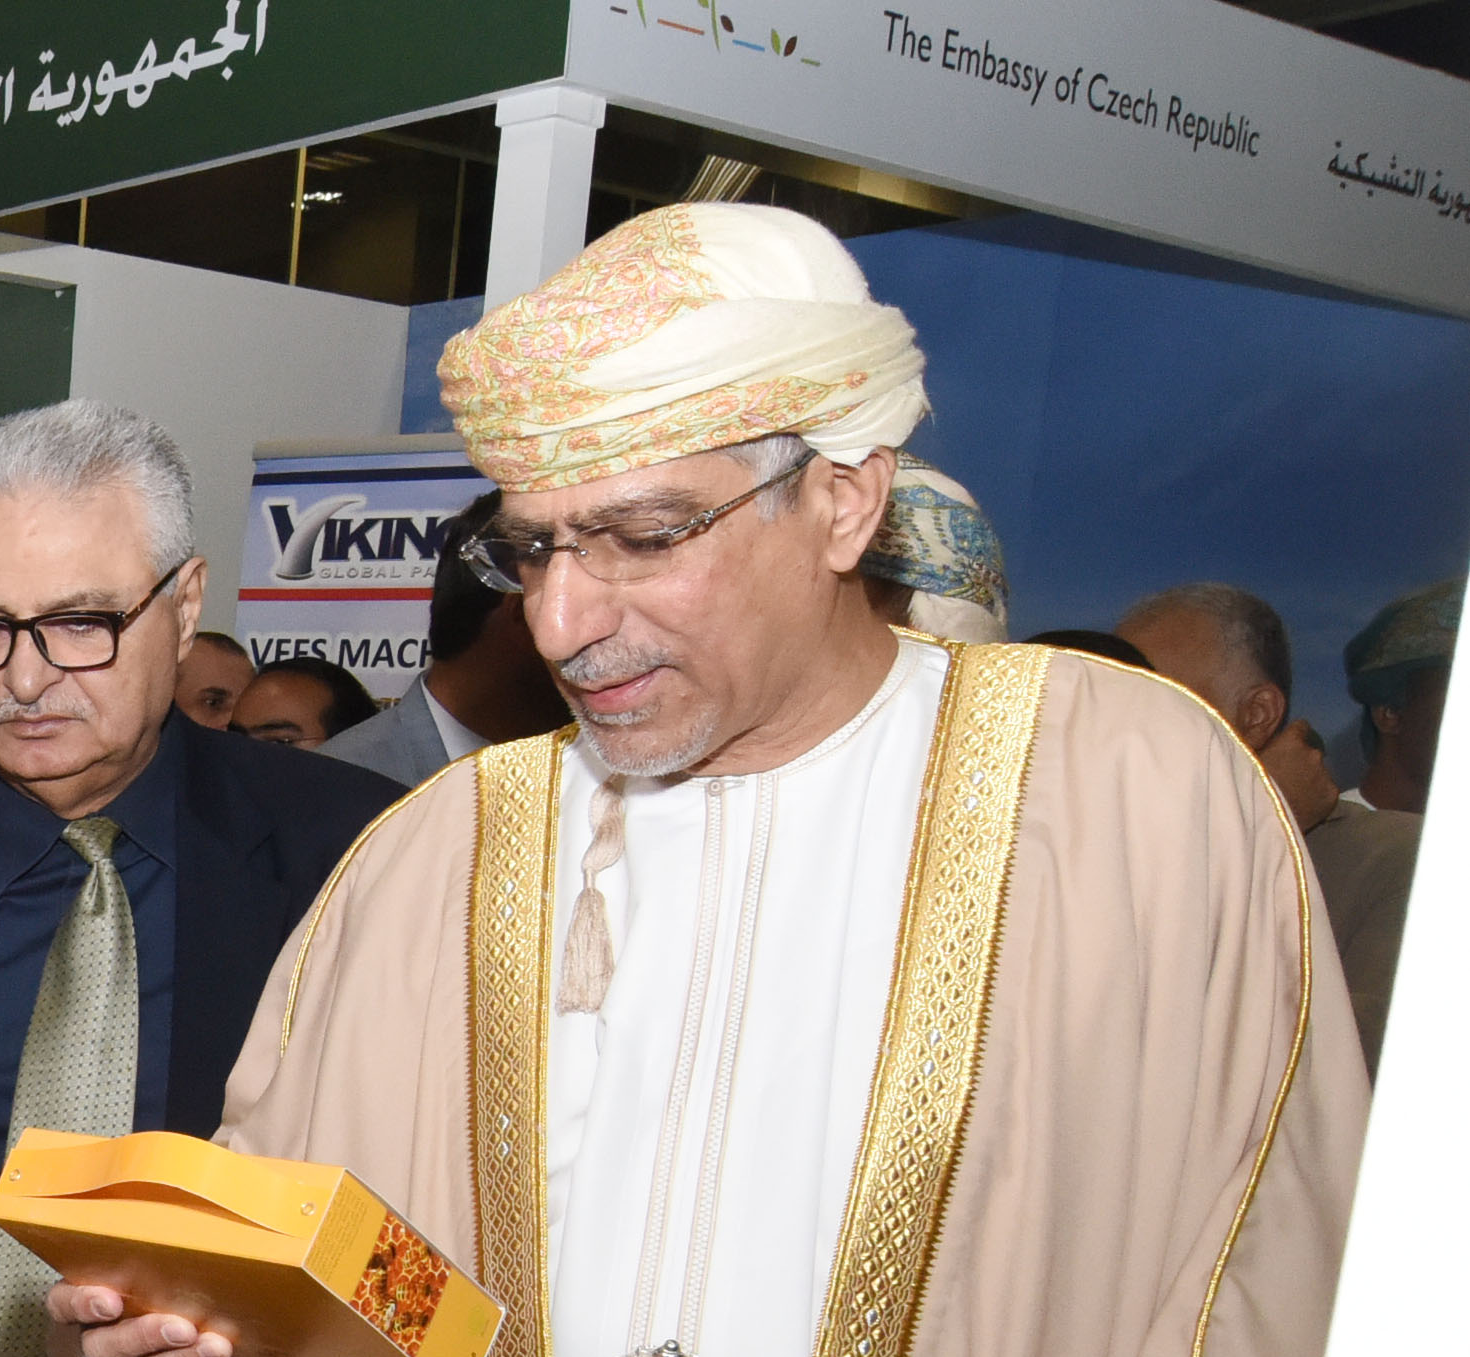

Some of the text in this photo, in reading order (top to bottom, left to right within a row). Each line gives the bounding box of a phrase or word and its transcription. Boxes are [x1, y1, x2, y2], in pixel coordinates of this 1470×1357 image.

[28, 0, 269, 127] الجمهورية
[884, 10, 1260, 157] The Embassy of Czech Republic
[1327, 140, 1426, 198] التشيكية
[319, 566, 402, 580] GLOBAL
[339, 638, 432, 668] MACH
